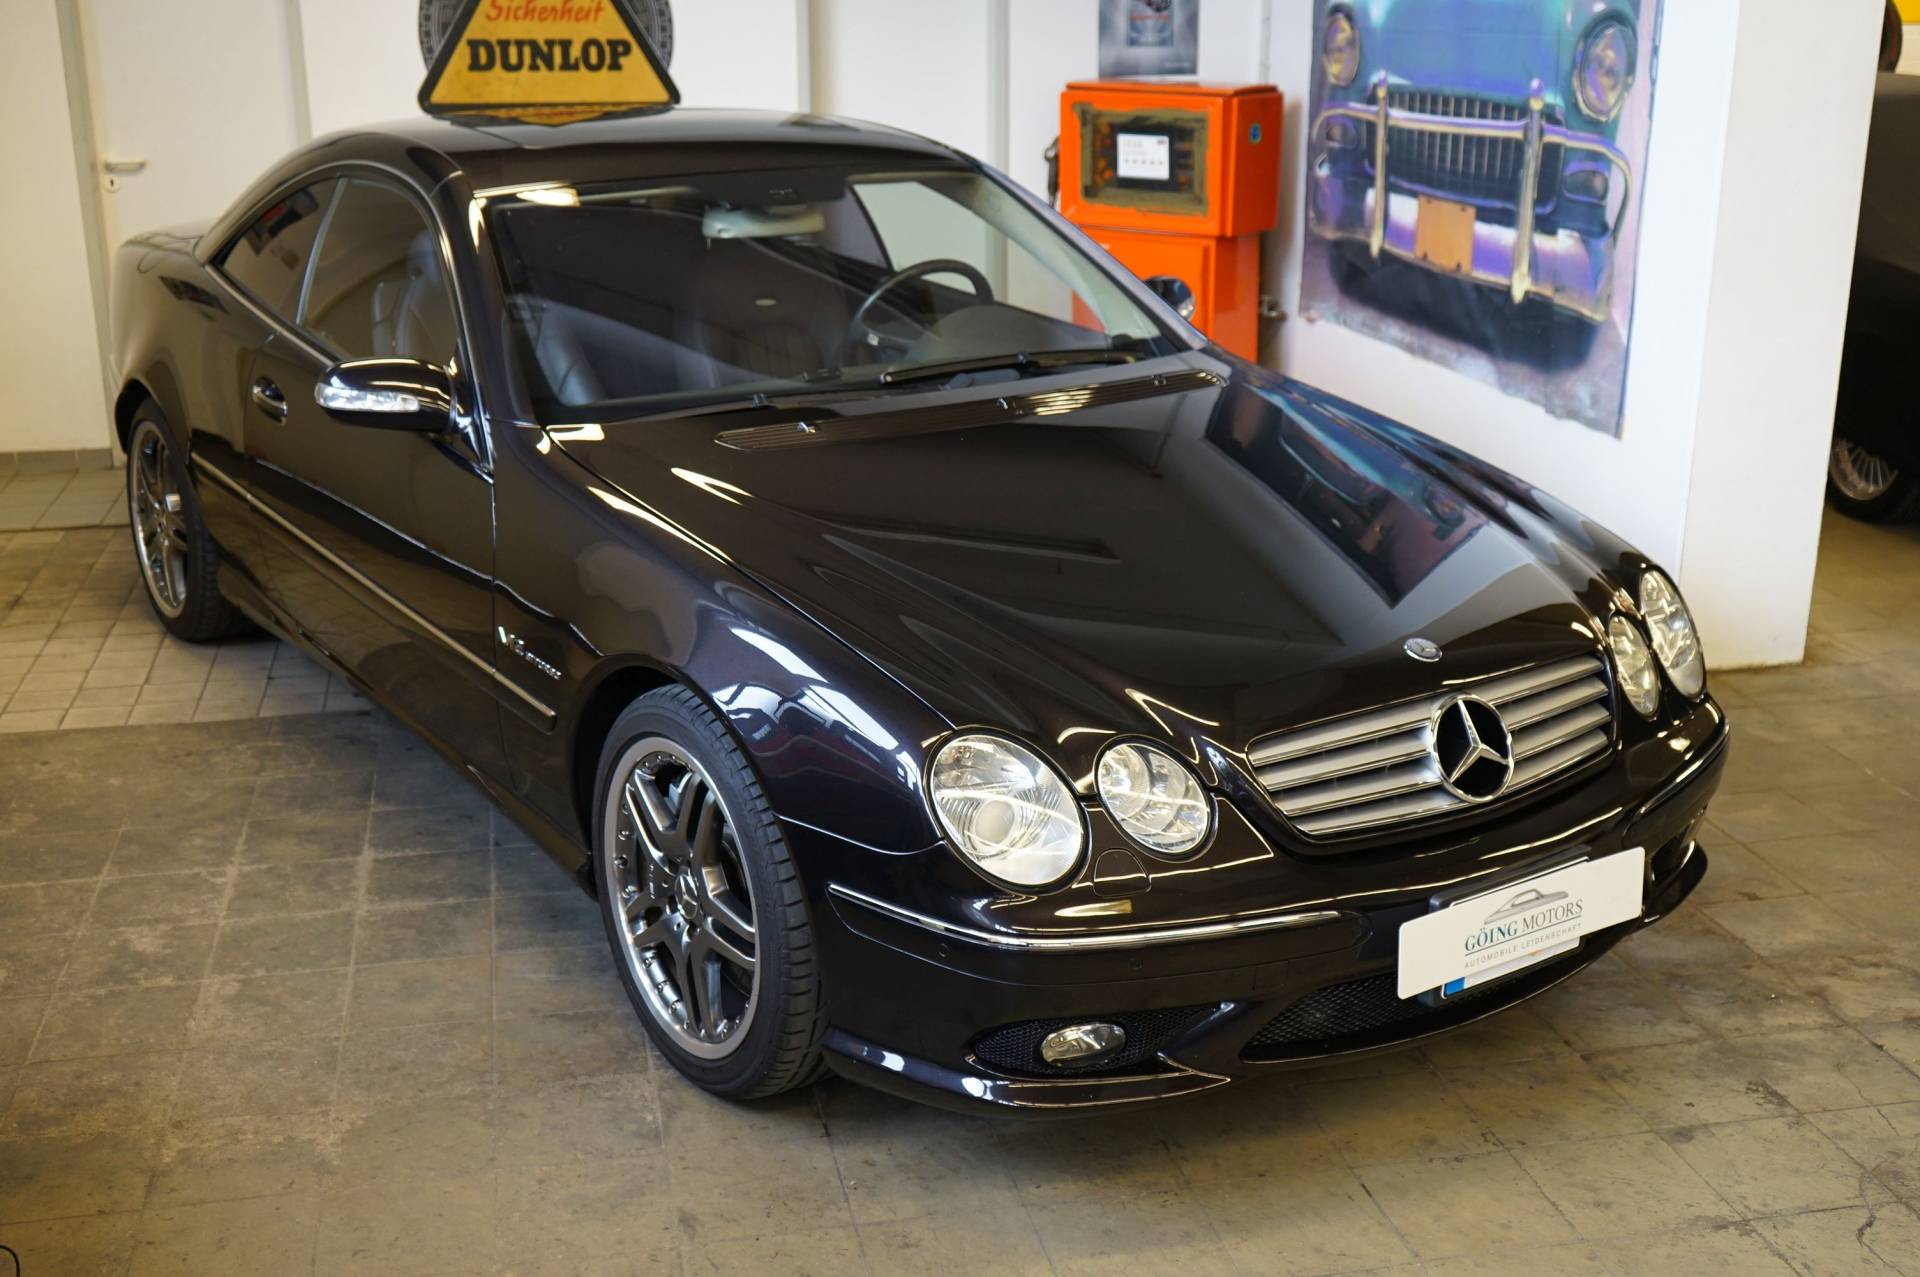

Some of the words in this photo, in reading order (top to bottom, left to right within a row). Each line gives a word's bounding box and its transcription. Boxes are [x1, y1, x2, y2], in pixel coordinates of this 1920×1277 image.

[486, 0, 605, 22] Sicherheit
[466, 38, 632, 72] DUNLOP
[1464, 943, 1518, 968] AUTOMOBILE
[1520, 922, 1581, 950] LEIDENSCHAFT
[1465, 920, 1518, 951] GÖING
[1522, 899, 1583, 932] MOTORS
